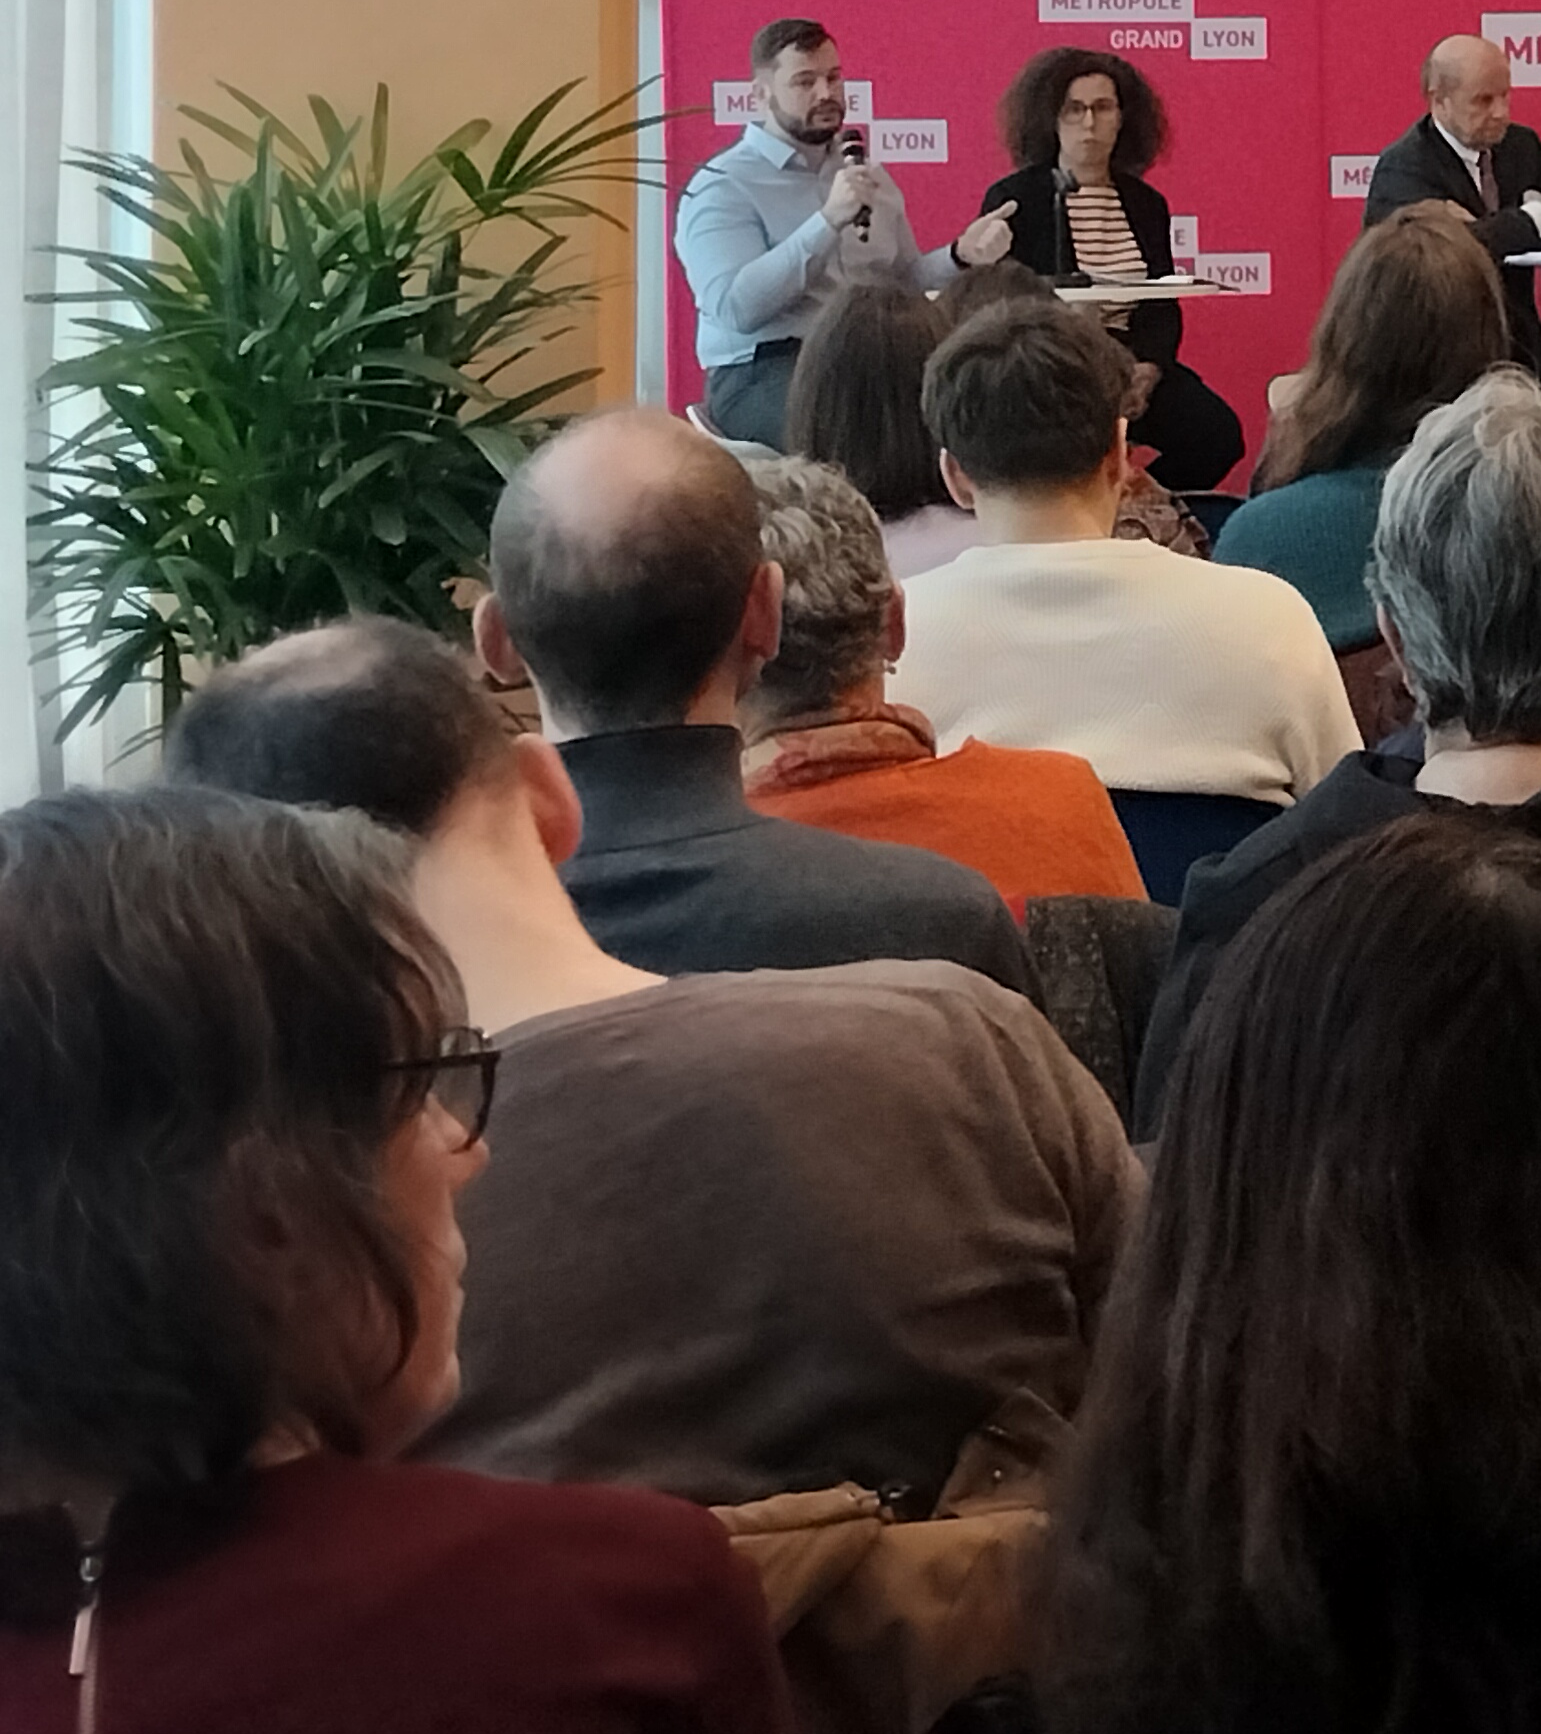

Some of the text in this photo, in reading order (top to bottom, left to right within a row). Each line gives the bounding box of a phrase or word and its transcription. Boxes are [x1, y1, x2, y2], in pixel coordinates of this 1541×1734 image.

[1110, 30, 1254, 49] GRAND LYON
[883, 133, 934, 150] LYON
